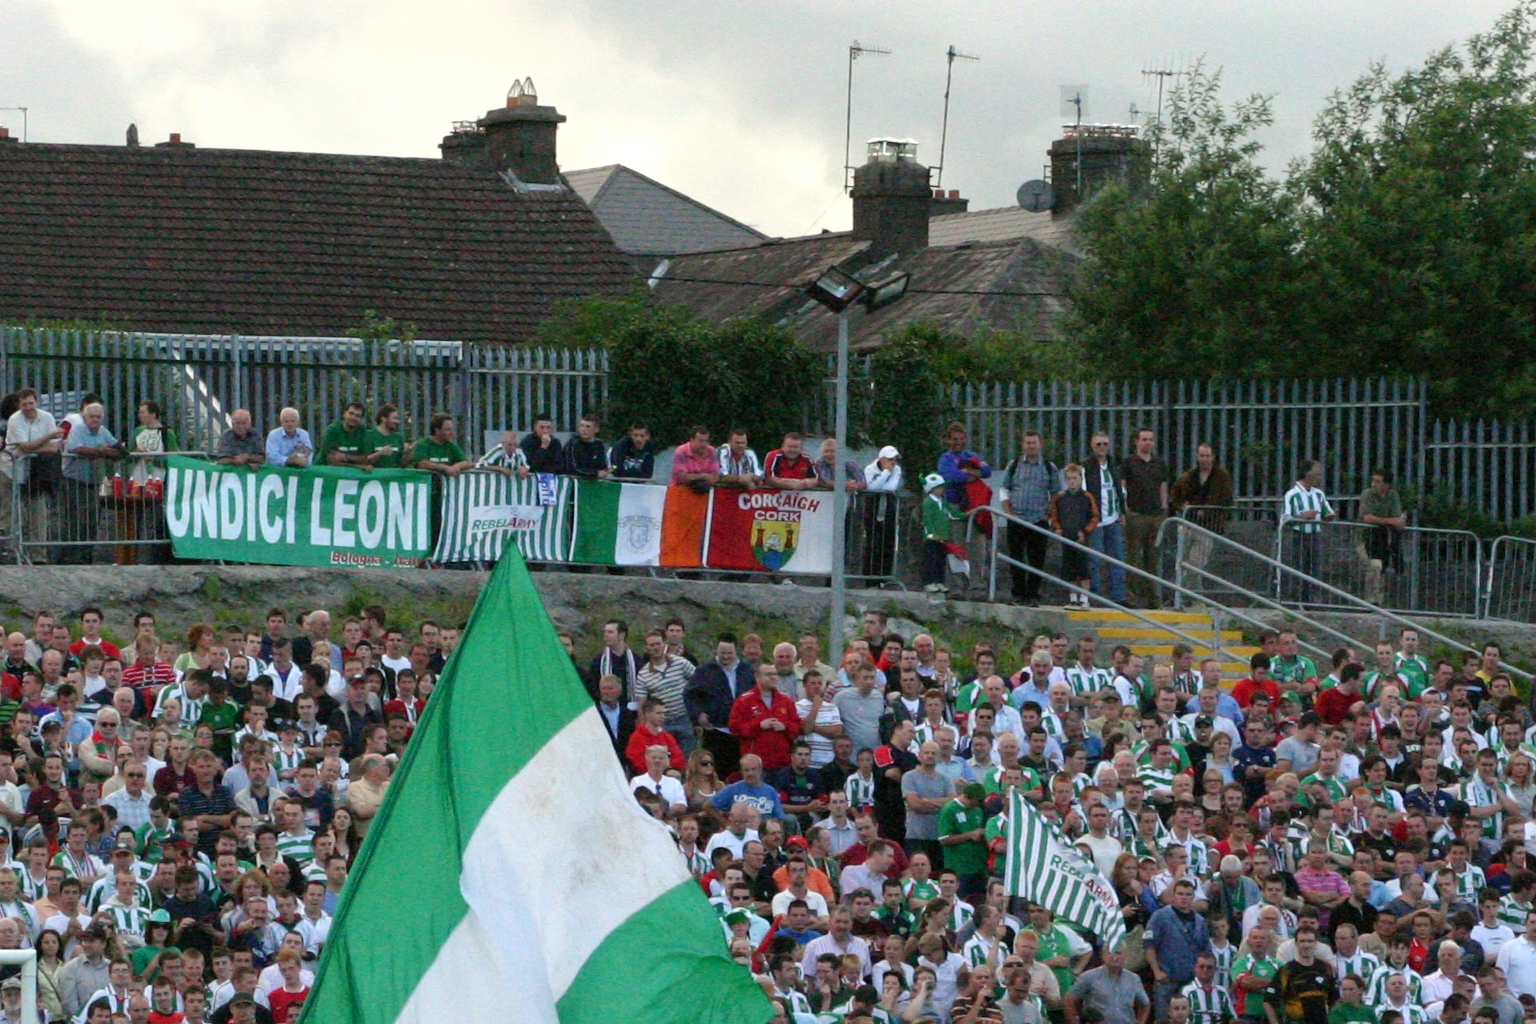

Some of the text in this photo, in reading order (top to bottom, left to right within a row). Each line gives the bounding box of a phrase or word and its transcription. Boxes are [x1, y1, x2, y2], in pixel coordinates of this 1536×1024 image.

[166, 468, 428, 551] UNDICI LEONI
[754, 510, 800, 522] CORK
[330, 550, 382, 568] Bologna
